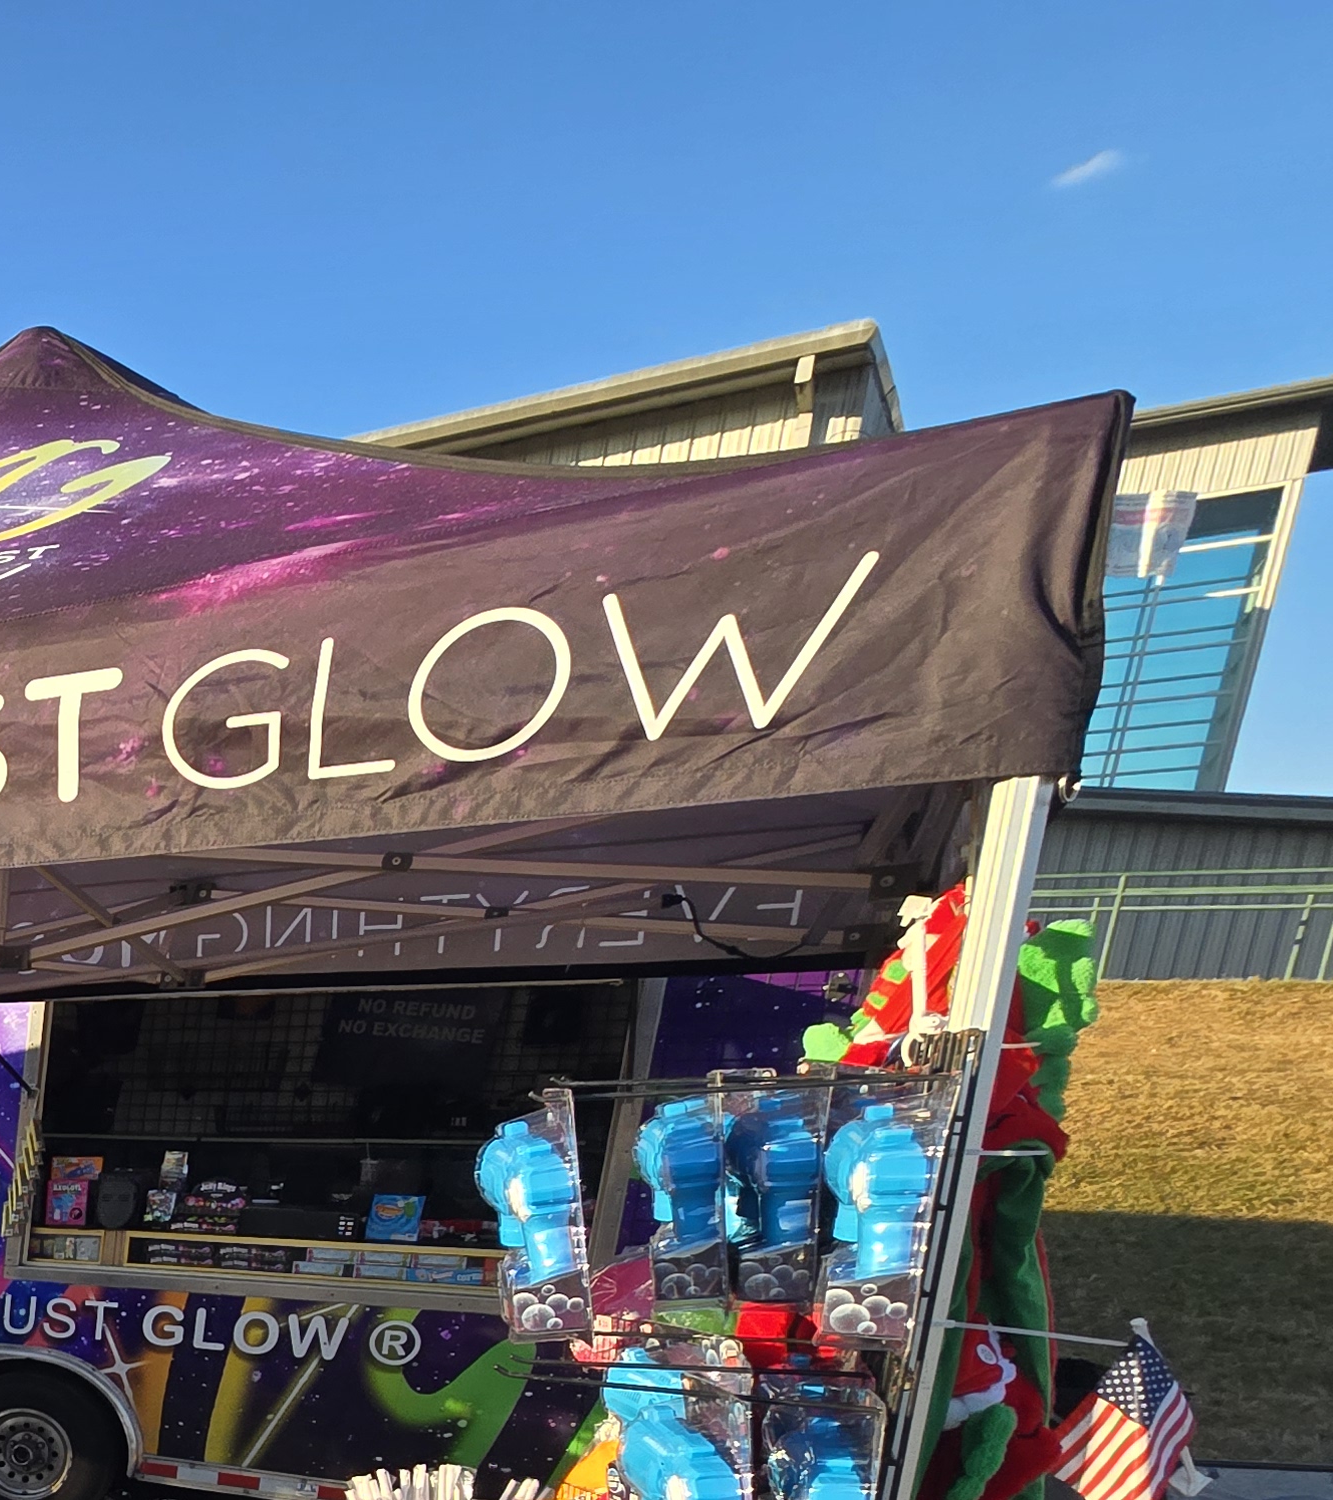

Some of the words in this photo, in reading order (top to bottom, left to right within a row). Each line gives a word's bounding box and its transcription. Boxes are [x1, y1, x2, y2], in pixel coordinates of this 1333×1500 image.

[162, 549, 880, 791] GLOW
[358, 997, 387, 1014] NO
[392, 1000, 476, 1020] REFUND
[338, 1019, 367, 1034] NO
[372, 1021, 485, 1044] EXCHANGE
[141, 1302, 366, 1361] GLOW
